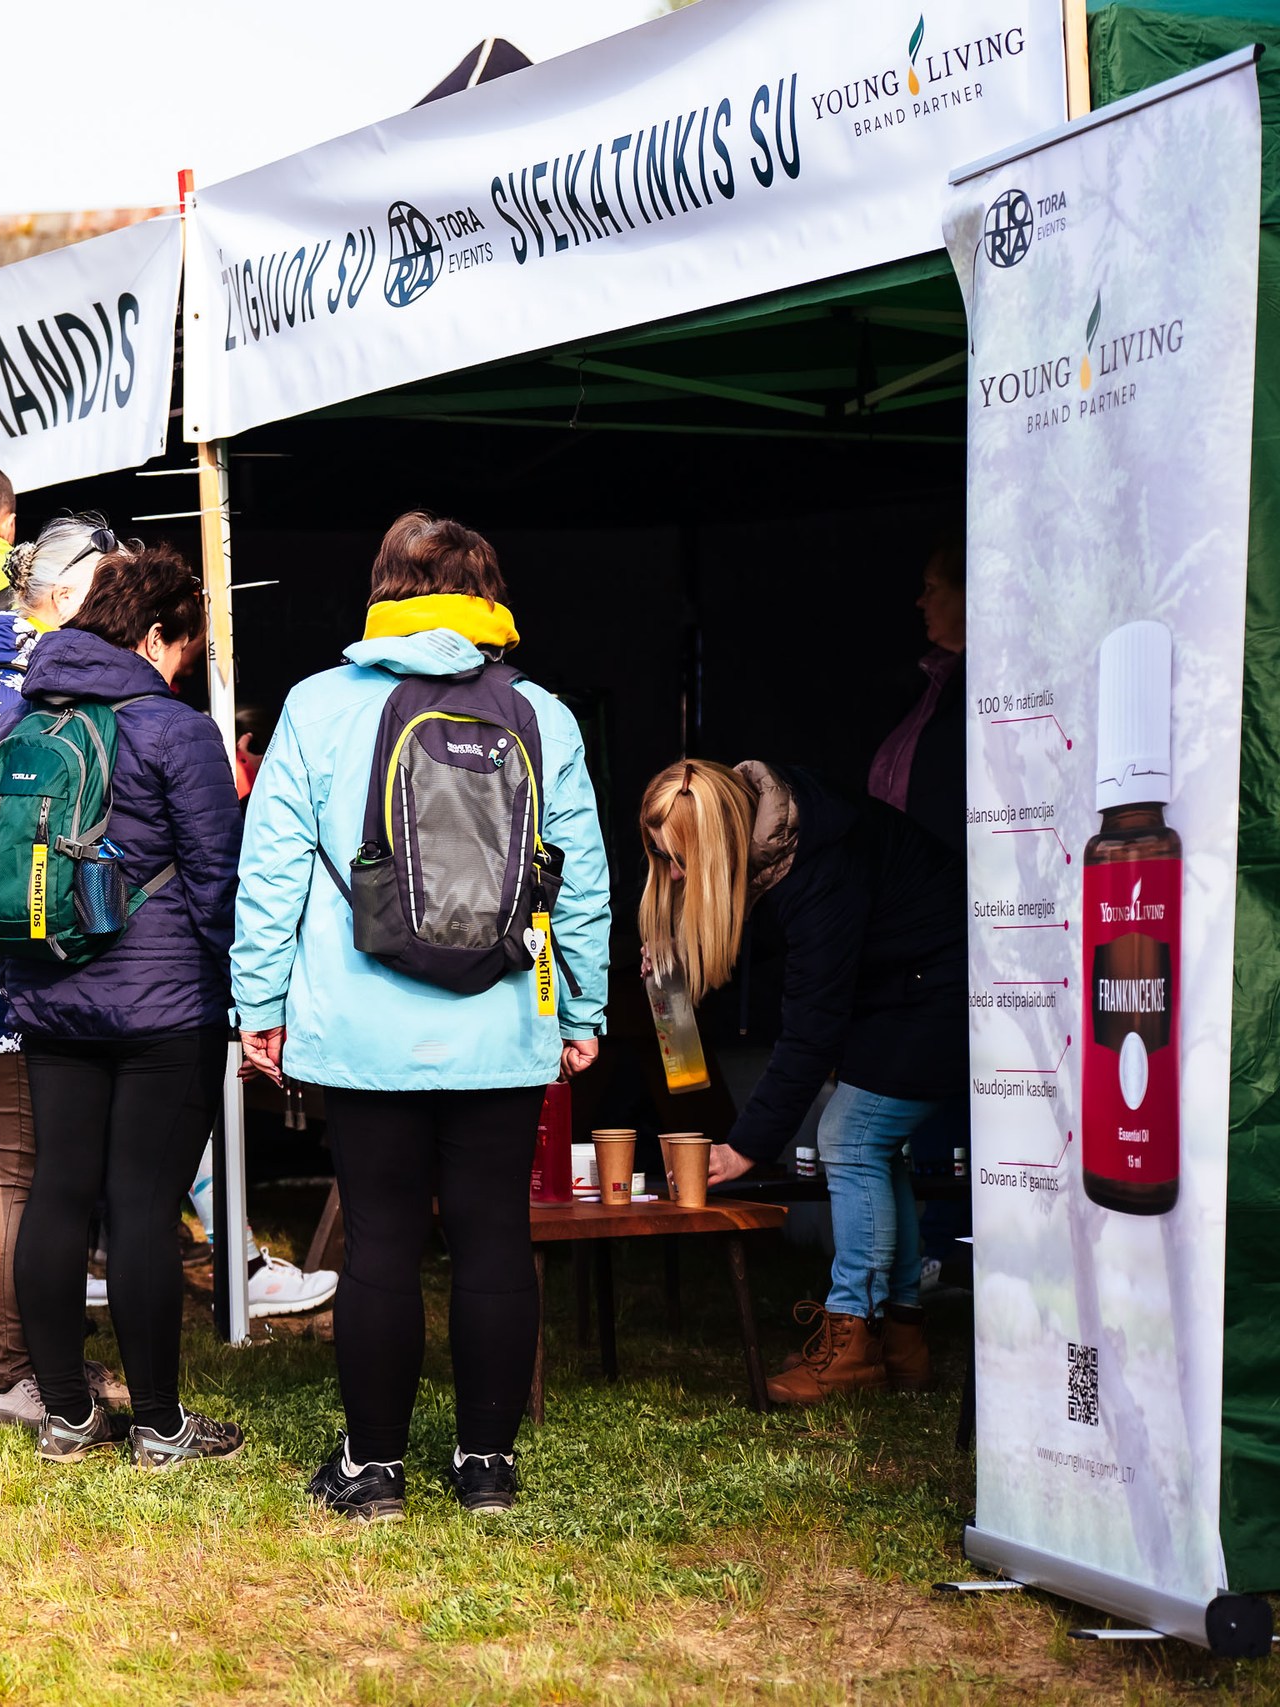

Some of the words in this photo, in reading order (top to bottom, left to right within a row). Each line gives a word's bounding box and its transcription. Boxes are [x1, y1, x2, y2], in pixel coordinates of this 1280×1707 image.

[811, 69, 900, 120] YOUNG
[925, 27, 1026, 83] LIVING
[854, 108, 906, 137] BRAND
[913, 83, 984, 119] PARTNER
[491, 97, 736, 265] SVEIKATINKIS
[749, 72, 801, 189] SU
[1037, 190, 1067, 218] TORA
[436, 206, 486, 242] TORA
[1037, 217, 1067, 241] EVENTS
[327, 226, 376, 314] SU
[448, 242, 494, 274] EVENTS
[979, 356, 1072, 408] YOUNG
[1099, 319, 1184, 376] LIVING
[1027, 404, 1071, 433] BRAND
[1080, 382, 1137, 418] PARTNER
[977, 696, 1000, 715] 100
[1003, 695, 1014, 712] %
[1016, 690, 1054, 710] natūralūs
[1019, 801, 1055, 822] emocijas
[33, 861, 45, 928] TrenkTiTos
[974, 900, 1015, 917] Suteikia
[1018, 898, 1056, 919] energijos
[539, 930, 551, 1002] TnkTiTos
[996, 991, 1056, 1011] atsipalaiduoti
[1099, 978, 1166, 1013] FRANKINCENSE
[973, 1079, 1024, 1099] Naudojami
[1026, 1080, 1058, 1098] kasdien
[1128, 1154, 1134, 1168] 15
[980, 1168, 1017, 1187] Dovana
[1019, 1171, 1027, 1188] iš
[1029, 1176, 1059, 1192] gamtos
